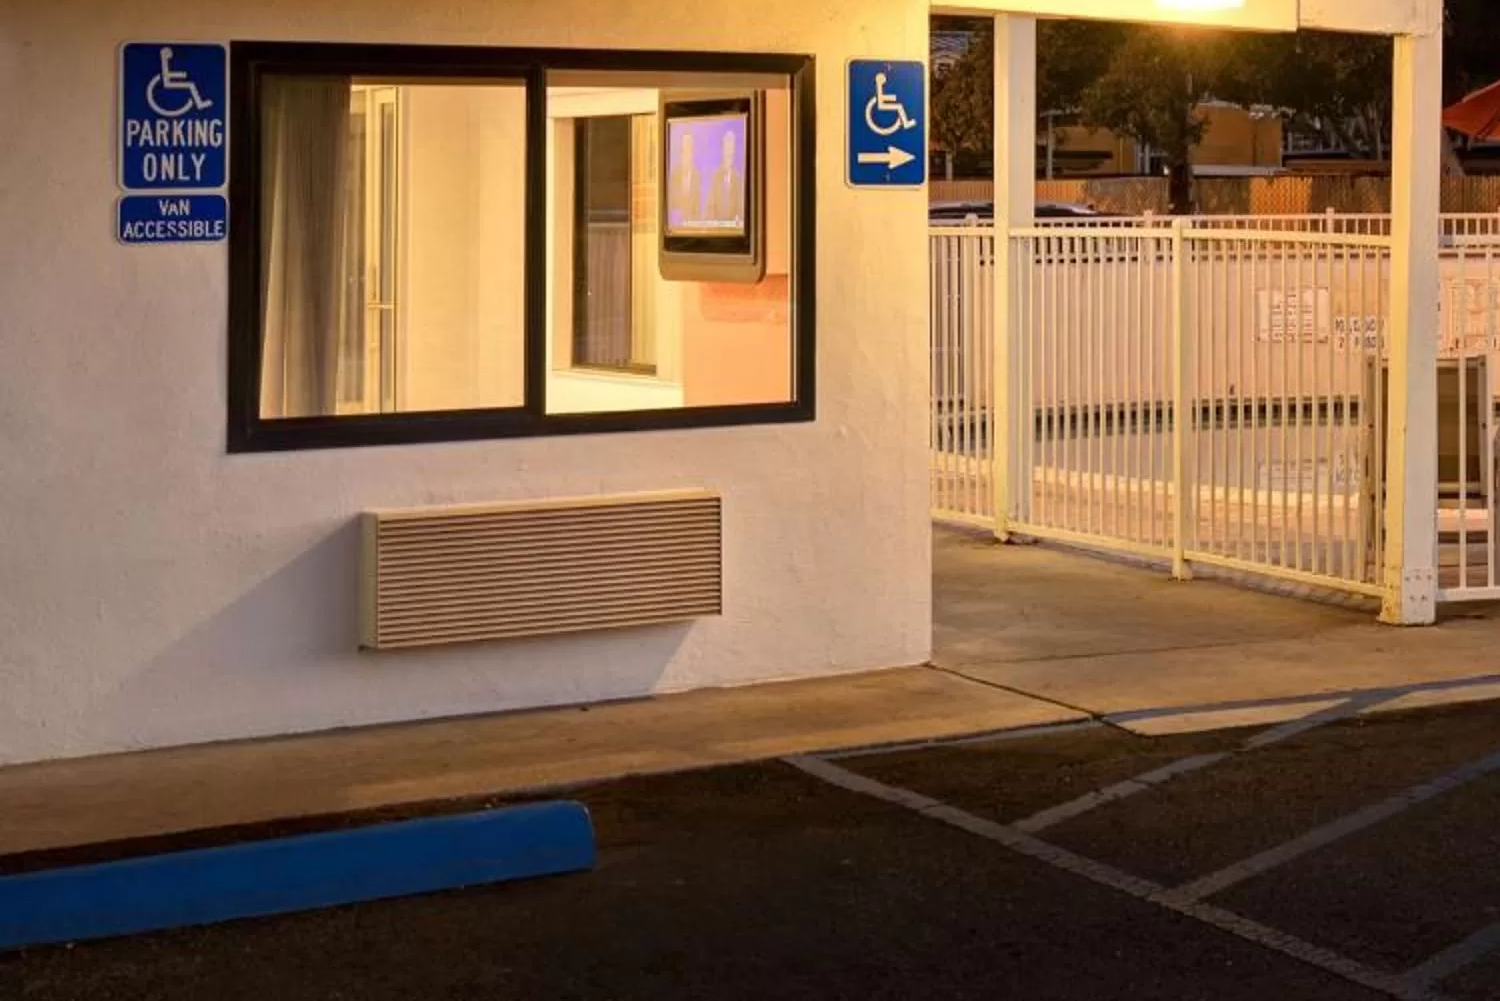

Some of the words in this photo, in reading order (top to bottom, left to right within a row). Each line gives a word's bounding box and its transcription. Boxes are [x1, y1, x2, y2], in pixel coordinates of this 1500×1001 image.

[126, 118, 223, 149] PARKING
[143, 153, 206, 182] ONLY
[159, 199, 190, 216] VAN
[123, 220, 225, 239] ACCESSIBLE
